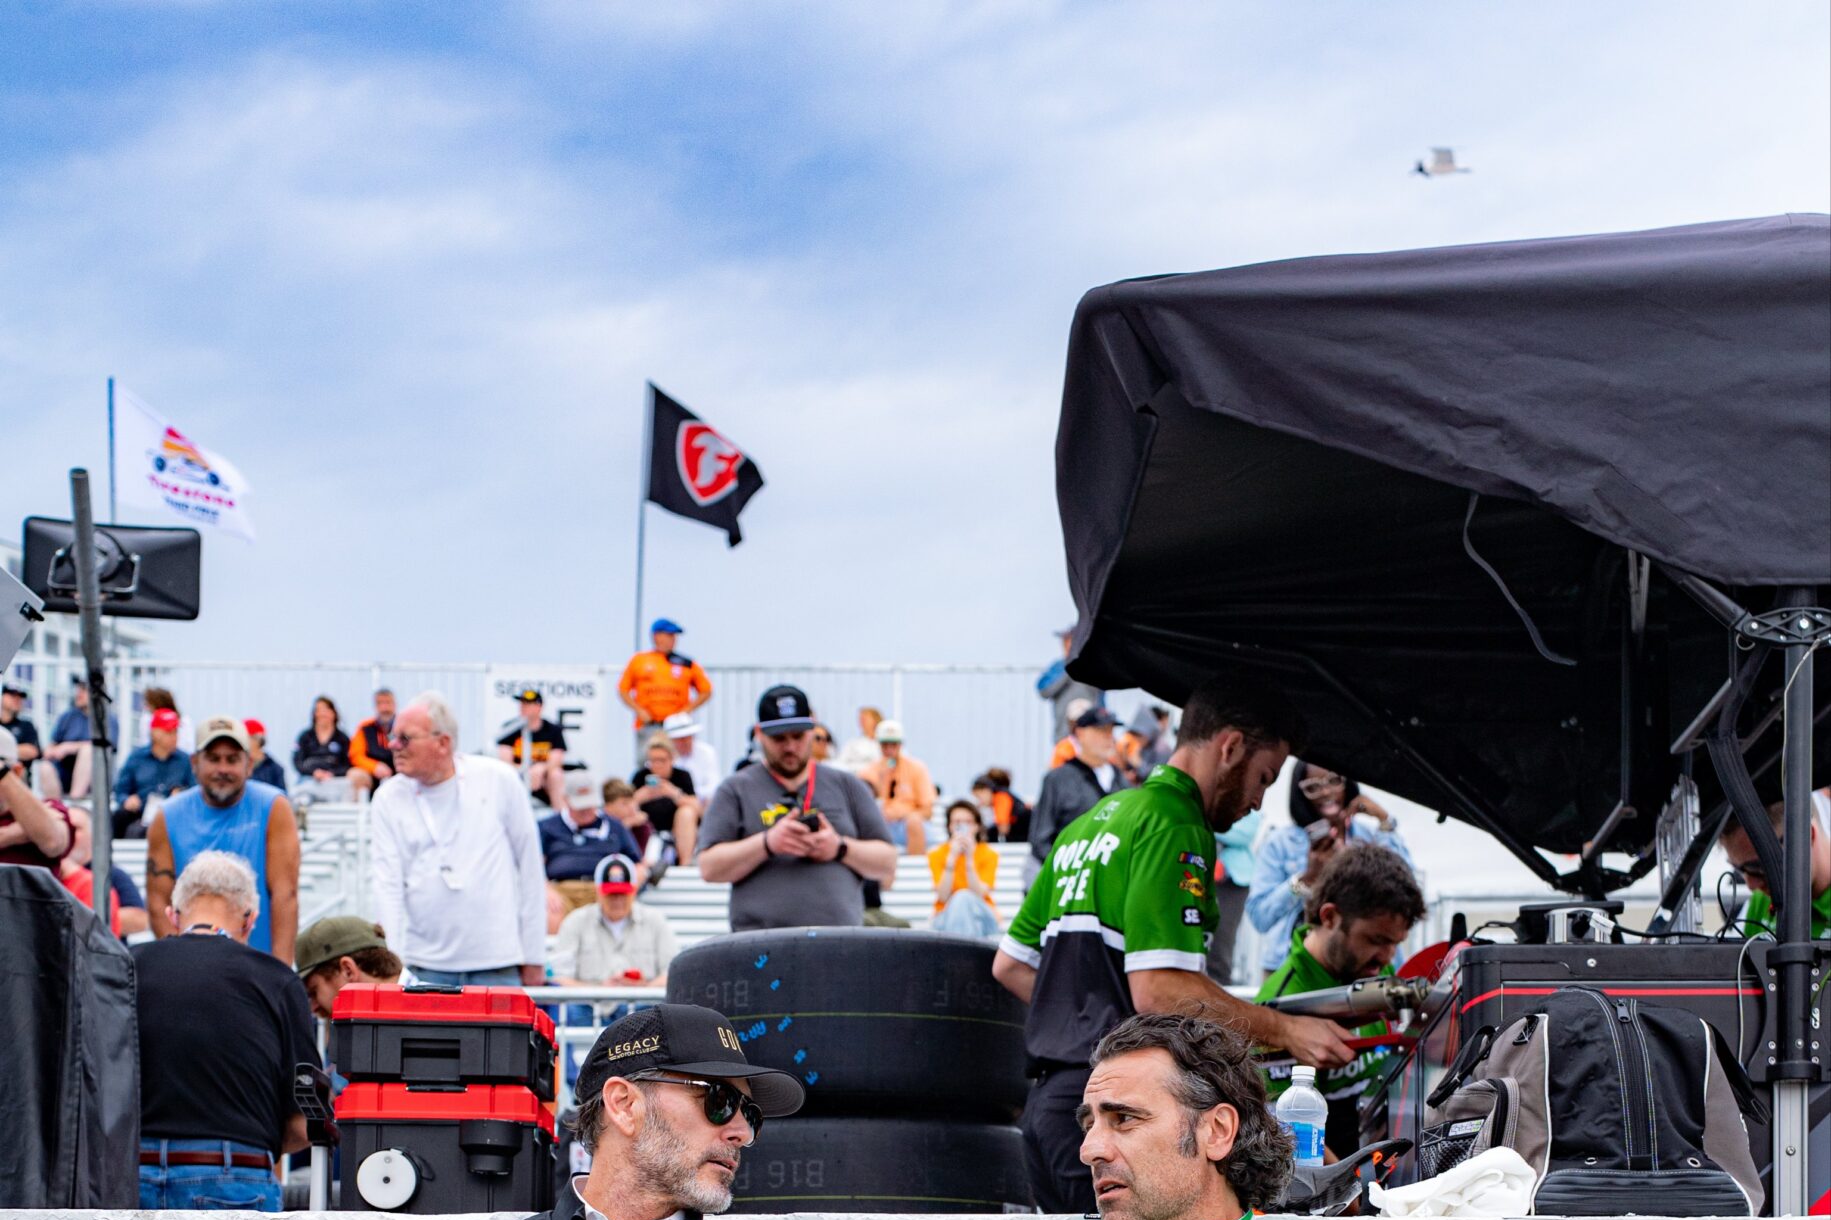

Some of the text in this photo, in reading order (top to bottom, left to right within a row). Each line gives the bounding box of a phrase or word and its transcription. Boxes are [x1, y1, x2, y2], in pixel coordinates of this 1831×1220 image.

[608, 1035, 660, 1057] LEGACY
[616, 1048, 650, 1060] MOTOR CLUB
